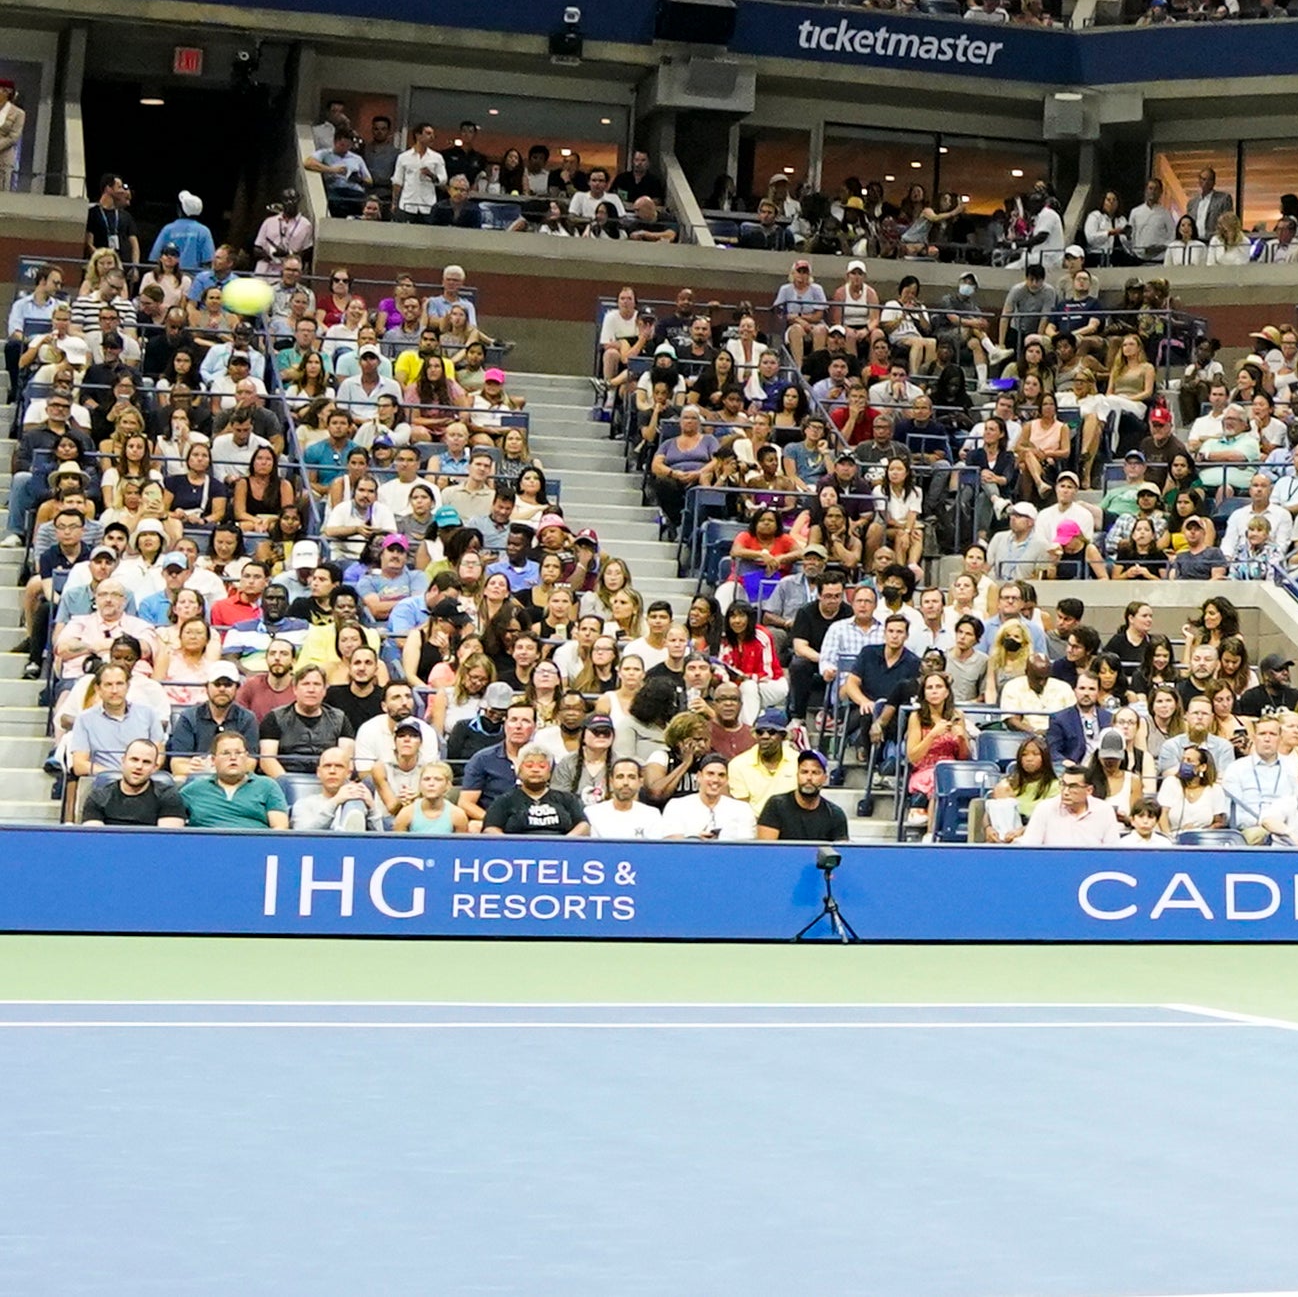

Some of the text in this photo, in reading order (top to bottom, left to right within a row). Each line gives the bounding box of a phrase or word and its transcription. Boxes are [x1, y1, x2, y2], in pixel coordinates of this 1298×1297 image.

[798, 18, 1004, 66] ticketmaster
[263, 854, 426, 918] IHG
[453, 858, 637, 886] HOTELS &
[452, 893, 635, 921] RESORTS
